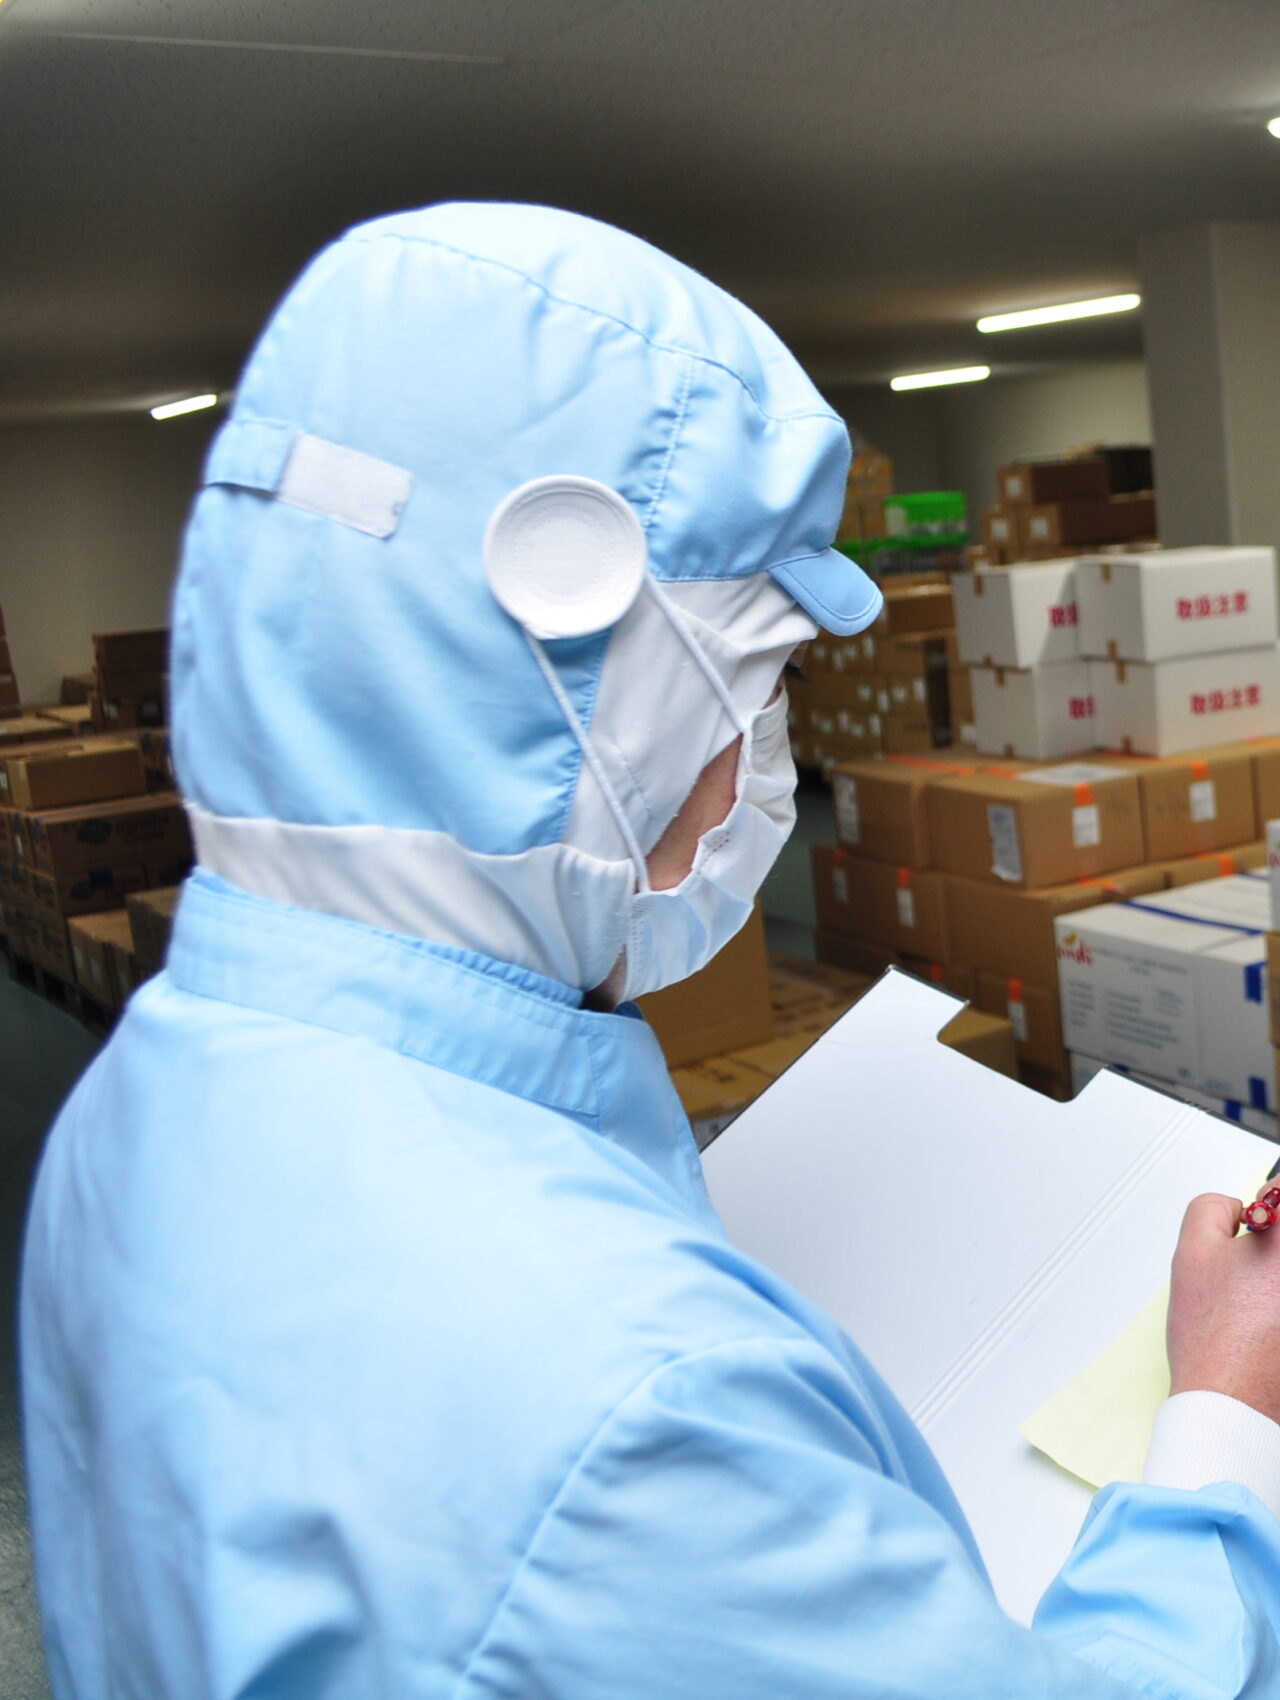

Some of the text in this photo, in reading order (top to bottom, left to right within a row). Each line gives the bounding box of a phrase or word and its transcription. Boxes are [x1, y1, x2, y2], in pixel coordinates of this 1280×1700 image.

[1175, 590, 1249, 621] 取扱注意
[1190, 683, 1261, 716] 取扱注意
